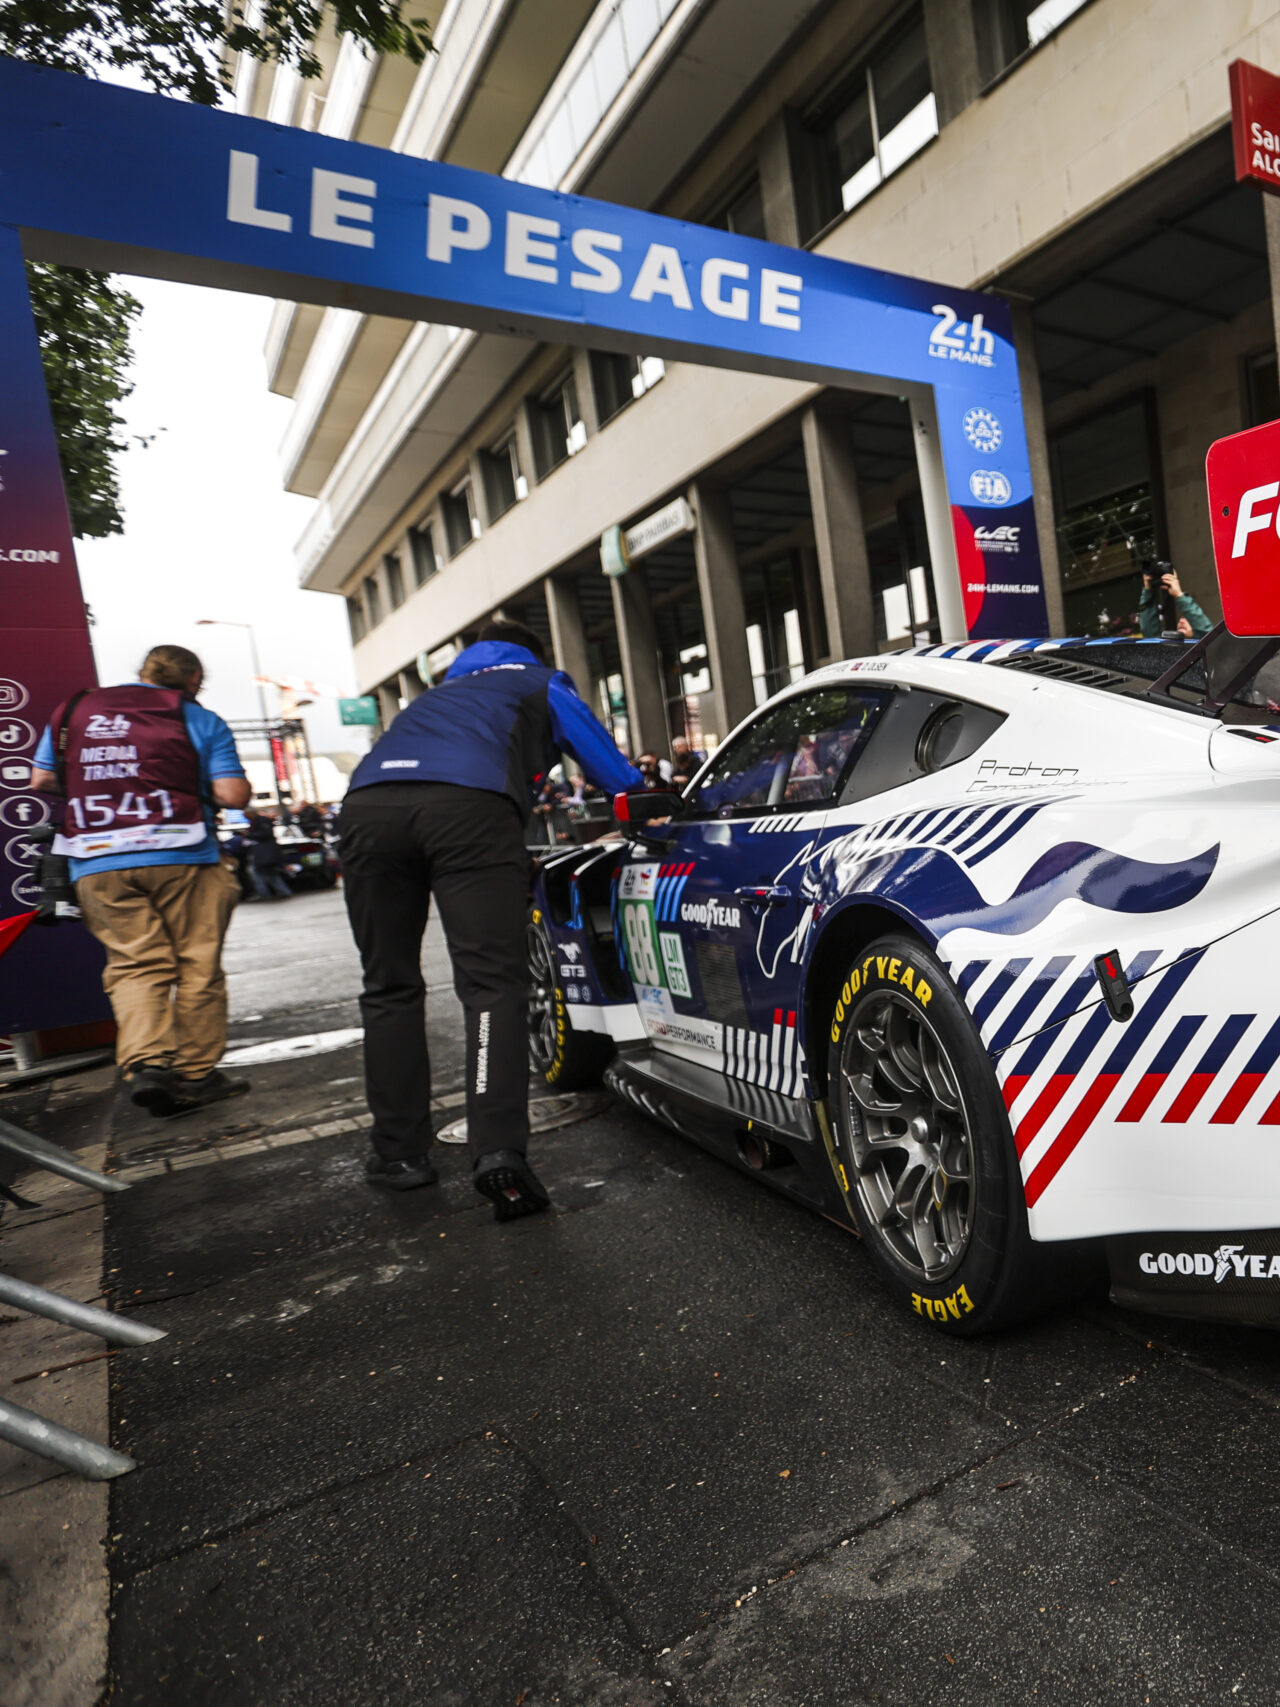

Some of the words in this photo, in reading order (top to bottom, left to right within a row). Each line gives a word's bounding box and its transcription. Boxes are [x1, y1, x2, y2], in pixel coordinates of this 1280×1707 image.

[227, 149, 377, 249] LE
[426, 193, 803, 332] PESAGE
[928, 344, 949, 360] LE
[949, 350, 993, 368] MANS
[972, 476, 1008, 498] FIA
[974, 526, 1021, 541] WEC
[80, 745, 138, 763] MEDIA
[83, 762, 141, 781] TRACK
[978, 760, 1079, 777] Proton
[68, 789, 174, 829] 1541
[681, 898, 741, 930] GOODYEAR
[624, 904, 660, 987] 88
[664, 938, 681, 964] LM
[560, 964, 587, 978] GT3
[667, 966, 688, 993] GT3
[830, 955, 934, 1044] GOODYEAR
[911, 1283, 975, 1322] EAGLE
